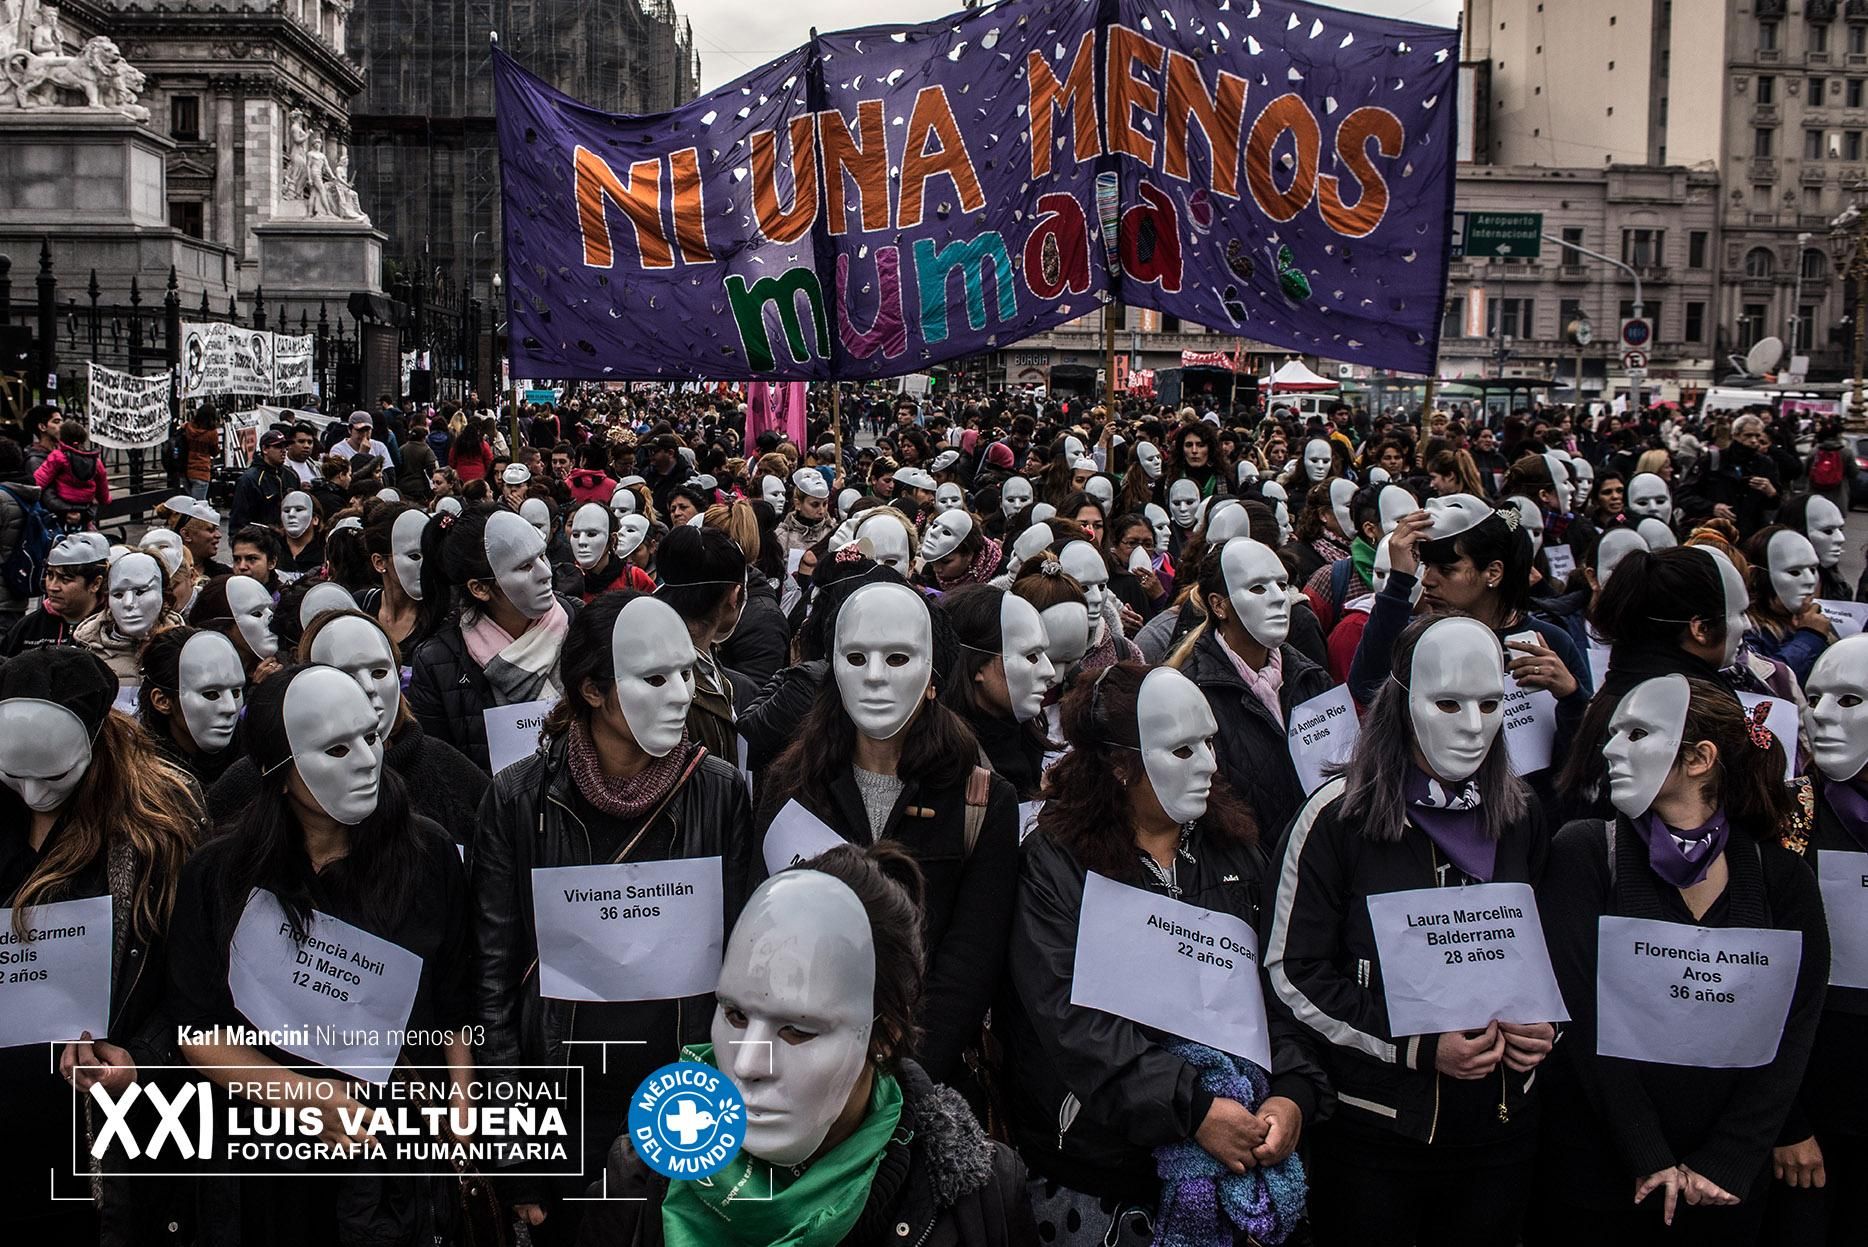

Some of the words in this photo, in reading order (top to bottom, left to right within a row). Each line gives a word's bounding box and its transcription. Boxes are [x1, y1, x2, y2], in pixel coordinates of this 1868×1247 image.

[574, 145, 716, 270] NI
[750, 84, 987, 246] UNA
[1028, 23, 1405, 239] MENOS
[1477, 215, 1534, 226] Aeropuerto
[1471, 229, 1537, 239] Internacional
[1014, 353, 1048, 366] BORGIA
[1297, 714, 1326, 733] Antonia
[1507, 714, 1535, 730] años
[1302, 734, 1312, 746] 67
[1312, 727, 1331, 742] años
[563, 889, 622, 903] Viviana
[626, 882, 694, 899] Santillán
[600, 906, 618, 920] 36
[622, 905, 661, 919] años
[1407, 914, 1450, 927] Laura
[1453, 905, 1523, 924] Marcelina
[28, 925, 86, 942] Carmen
[1147, 914, 1215, 947] Alejandra
[1426, 928, 1516, 946] Balderrama
[0, 948, 38, 965] Solís
[1177, 941, 1194, 958] 22
[1197, 952, 1234, 970] años
[1444, 950, 1463, 965] 28
[1467, 947, 1505, 962] años
[1634, 941, 1711, 963] Florencia
[1716, 950, 1769, 966] Analía
[295, 950, 314, 967] Di
[315, 958, 361, 986] Marco
[350, 951, 385, 976] Abril
[9, 968, 48, 983] años
[1682, 966, 1722, 983] Aros
[292, 970, 310, 988] 12
[312, 979, 349, 1002] años
[1669, 984, 1690, 999] 36
[1695, 988, 1735, 1004] años
